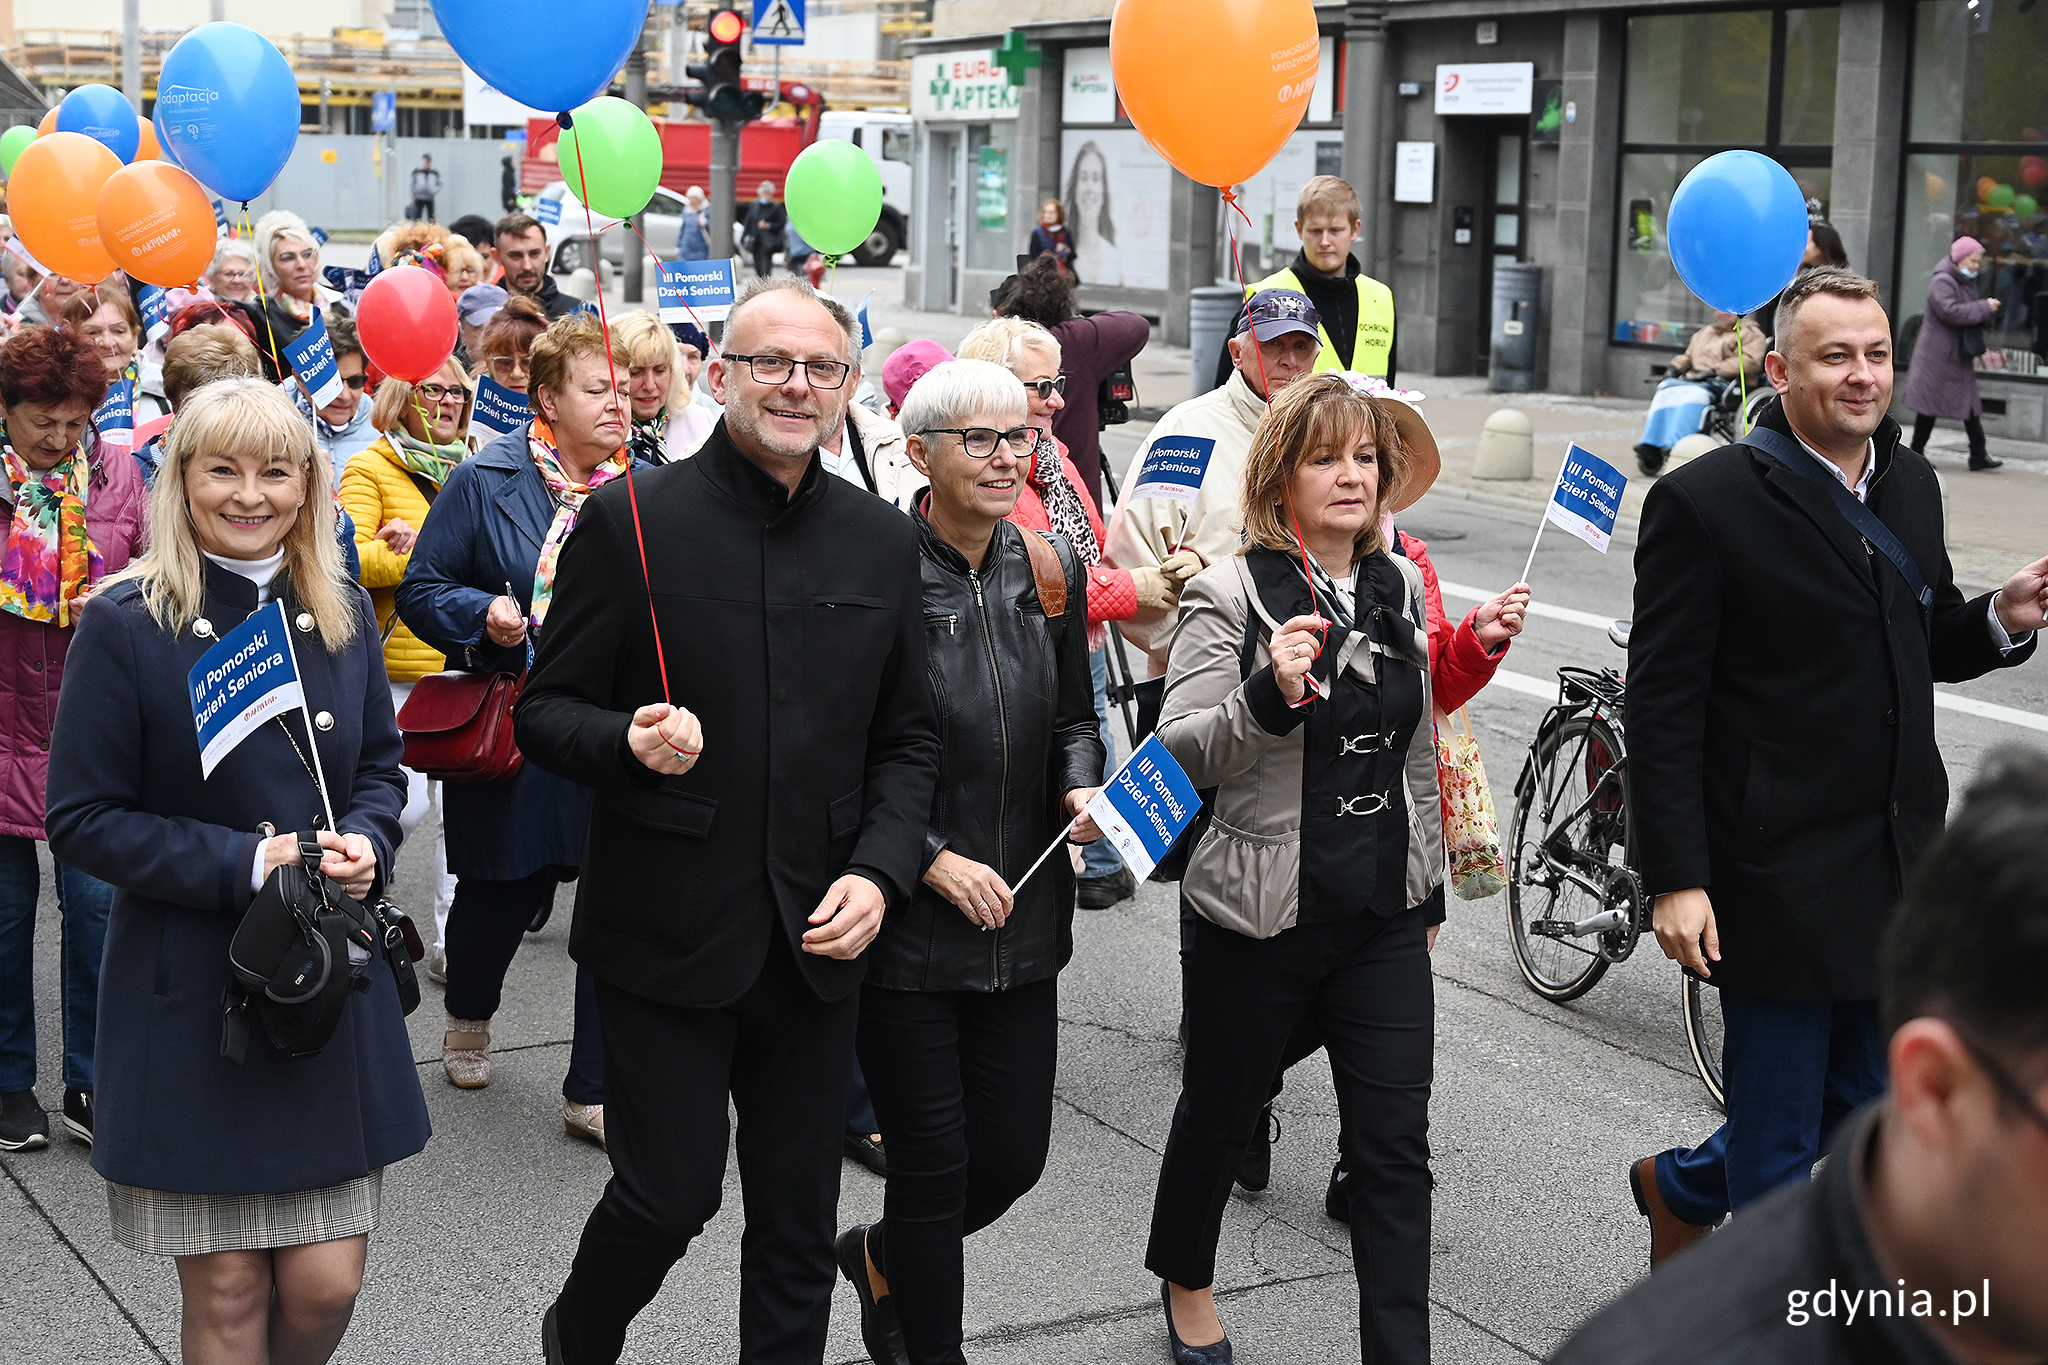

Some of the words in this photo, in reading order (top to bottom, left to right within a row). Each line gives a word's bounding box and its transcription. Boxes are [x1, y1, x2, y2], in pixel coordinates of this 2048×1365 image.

[161, 88, 219, 106] adaptacja
[663, 273, 673, 283] III
[674, 270, 723, 283] Pomorski
[658, 286, 689, 297] Dzień
[690, 285, 731, 296] Seniora
[1359, 323, 1389, 333] OCHRONA
[297, 350, 310, 365] III
[307, 330, 329, 357] Pomo
[1365, 338, 1387, 347] HORUS
[300, 354, 329, 383] Dzień
[483, 388, 493, 400] III
[95, 408, 132, 426] Seniora
[475, 400, 500, 420] Dzień
[502, 413, 529, 426] Seni
[1153, 448, 1201, 460] Pomorski
[1159, 460, 1201, 476] Seniora
[1566, 461, 1582, 476] III
[1581, 468, 1619, 501] Pomorski
[1588, 492, 1616, 520] Seniora
[195, 679, 206, 703] III
[206, 629, 269, 691] Pomorski
[195, 688, 227, 733] Dzień
[227, 652, 284, 698] Seniora
[1137, 756, 1155, 776] III
[1148, 769, 1187, 824] Pomorski
[1118, 767, 1151, 809] Dzień
[1145, 802, 1174, 847] Seniora
